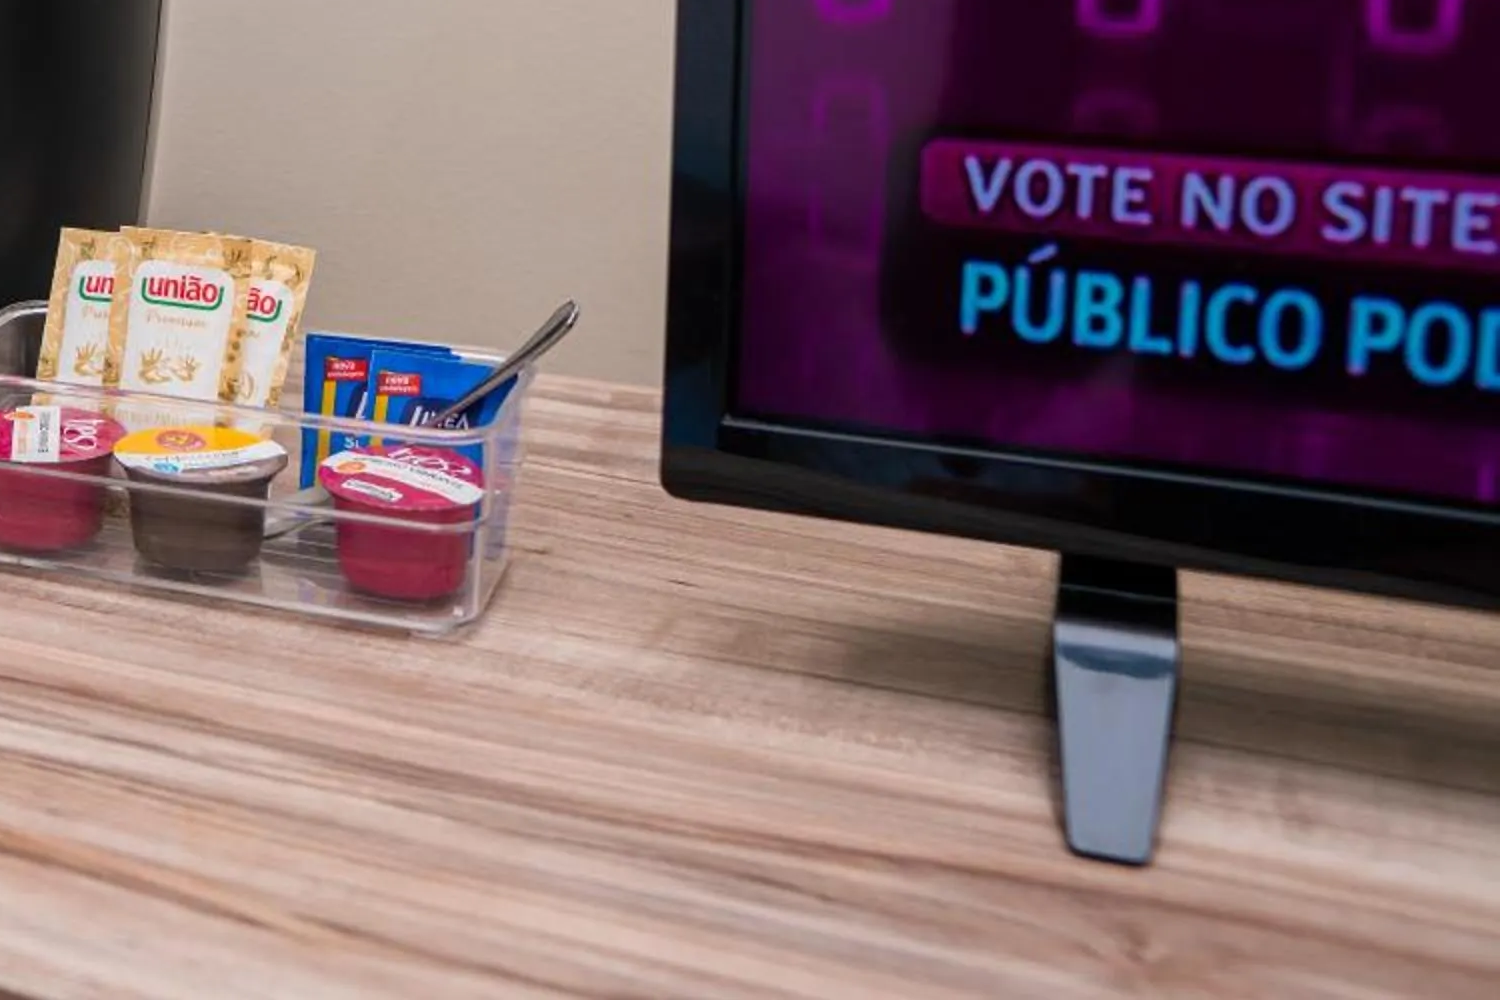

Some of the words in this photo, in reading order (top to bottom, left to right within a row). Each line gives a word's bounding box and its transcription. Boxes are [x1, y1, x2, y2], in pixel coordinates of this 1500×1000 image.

[963, 155, 1155, 225] VOTE
[1179, 171, 1297, 237] NO
[1320, 180, 1500, 255] SITE
[147, 274, 220, 304] união
[959, 242, 1324, 371] PÚBLICO
